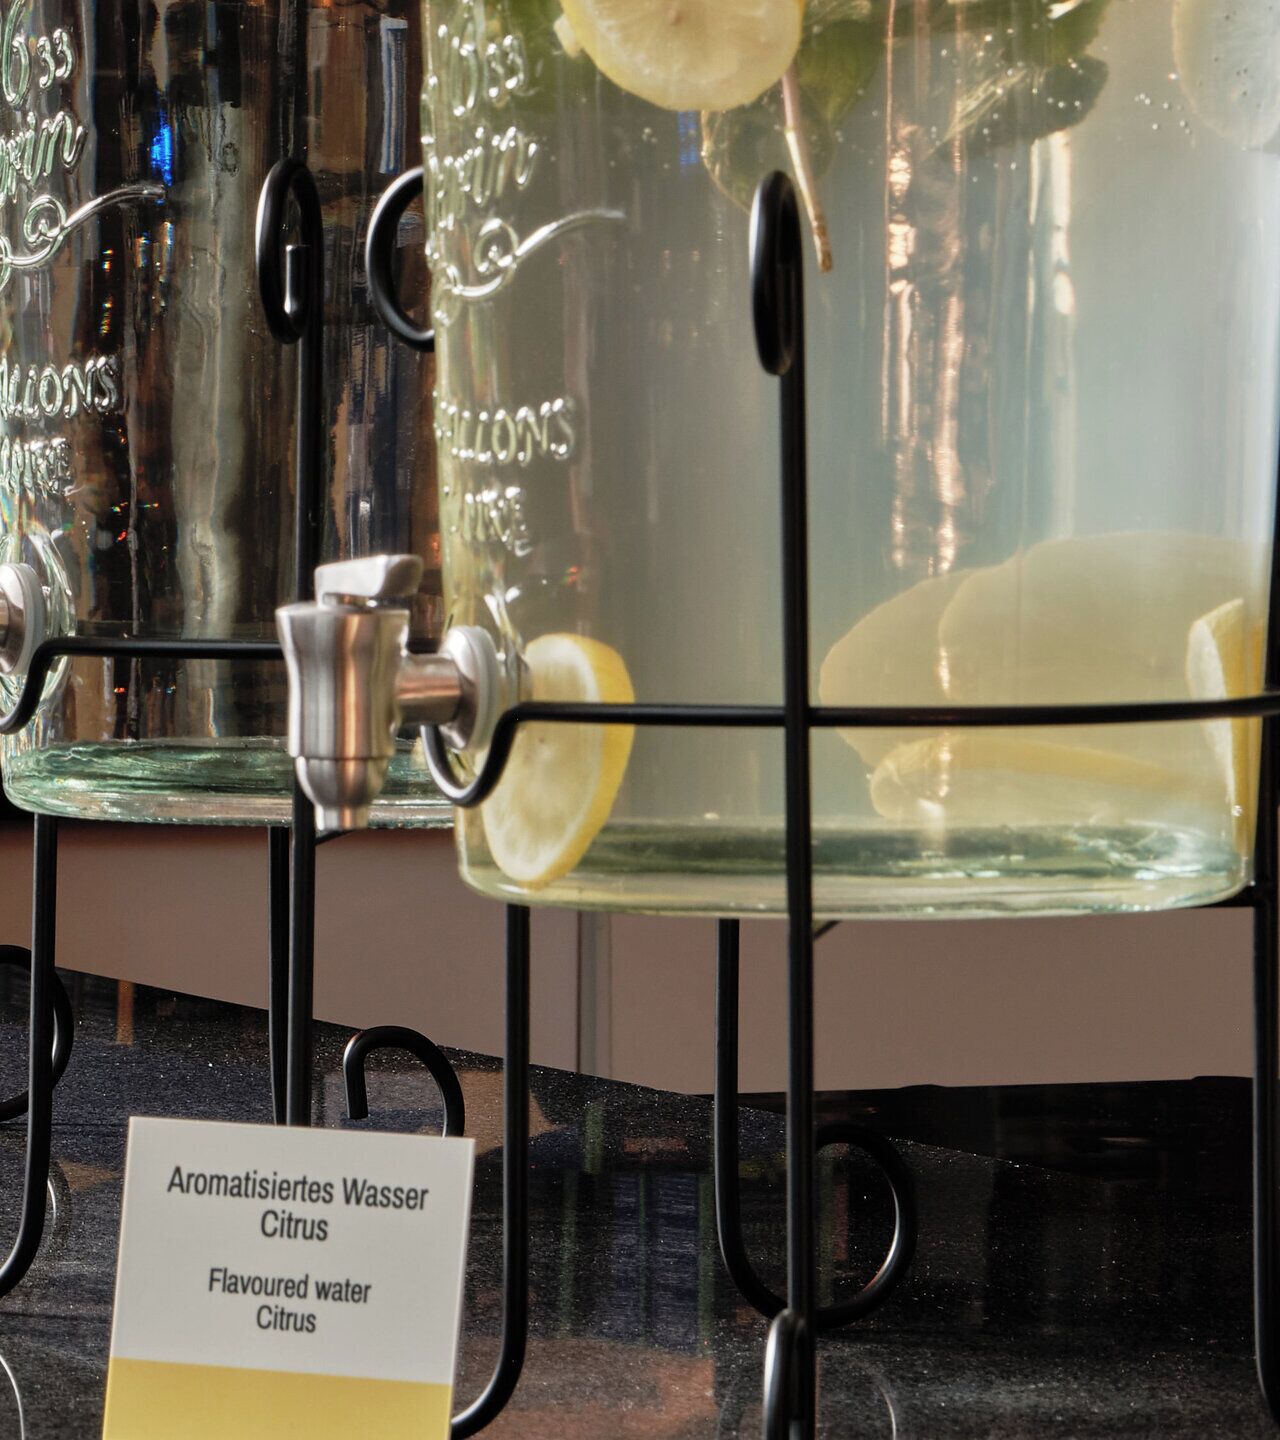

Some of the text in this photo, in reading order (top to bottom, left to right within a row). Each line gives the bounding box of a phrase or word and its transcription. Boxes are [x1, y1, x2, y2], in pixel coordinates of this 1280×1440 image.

[166, 1165, 429, 1211] Aromatisiertes Wasser
[260, 1209, 329, 1242] Citrus
[208, 1267, 372, 1304] Flavoured water
[256, 1304, 317, 1334] Citrus
